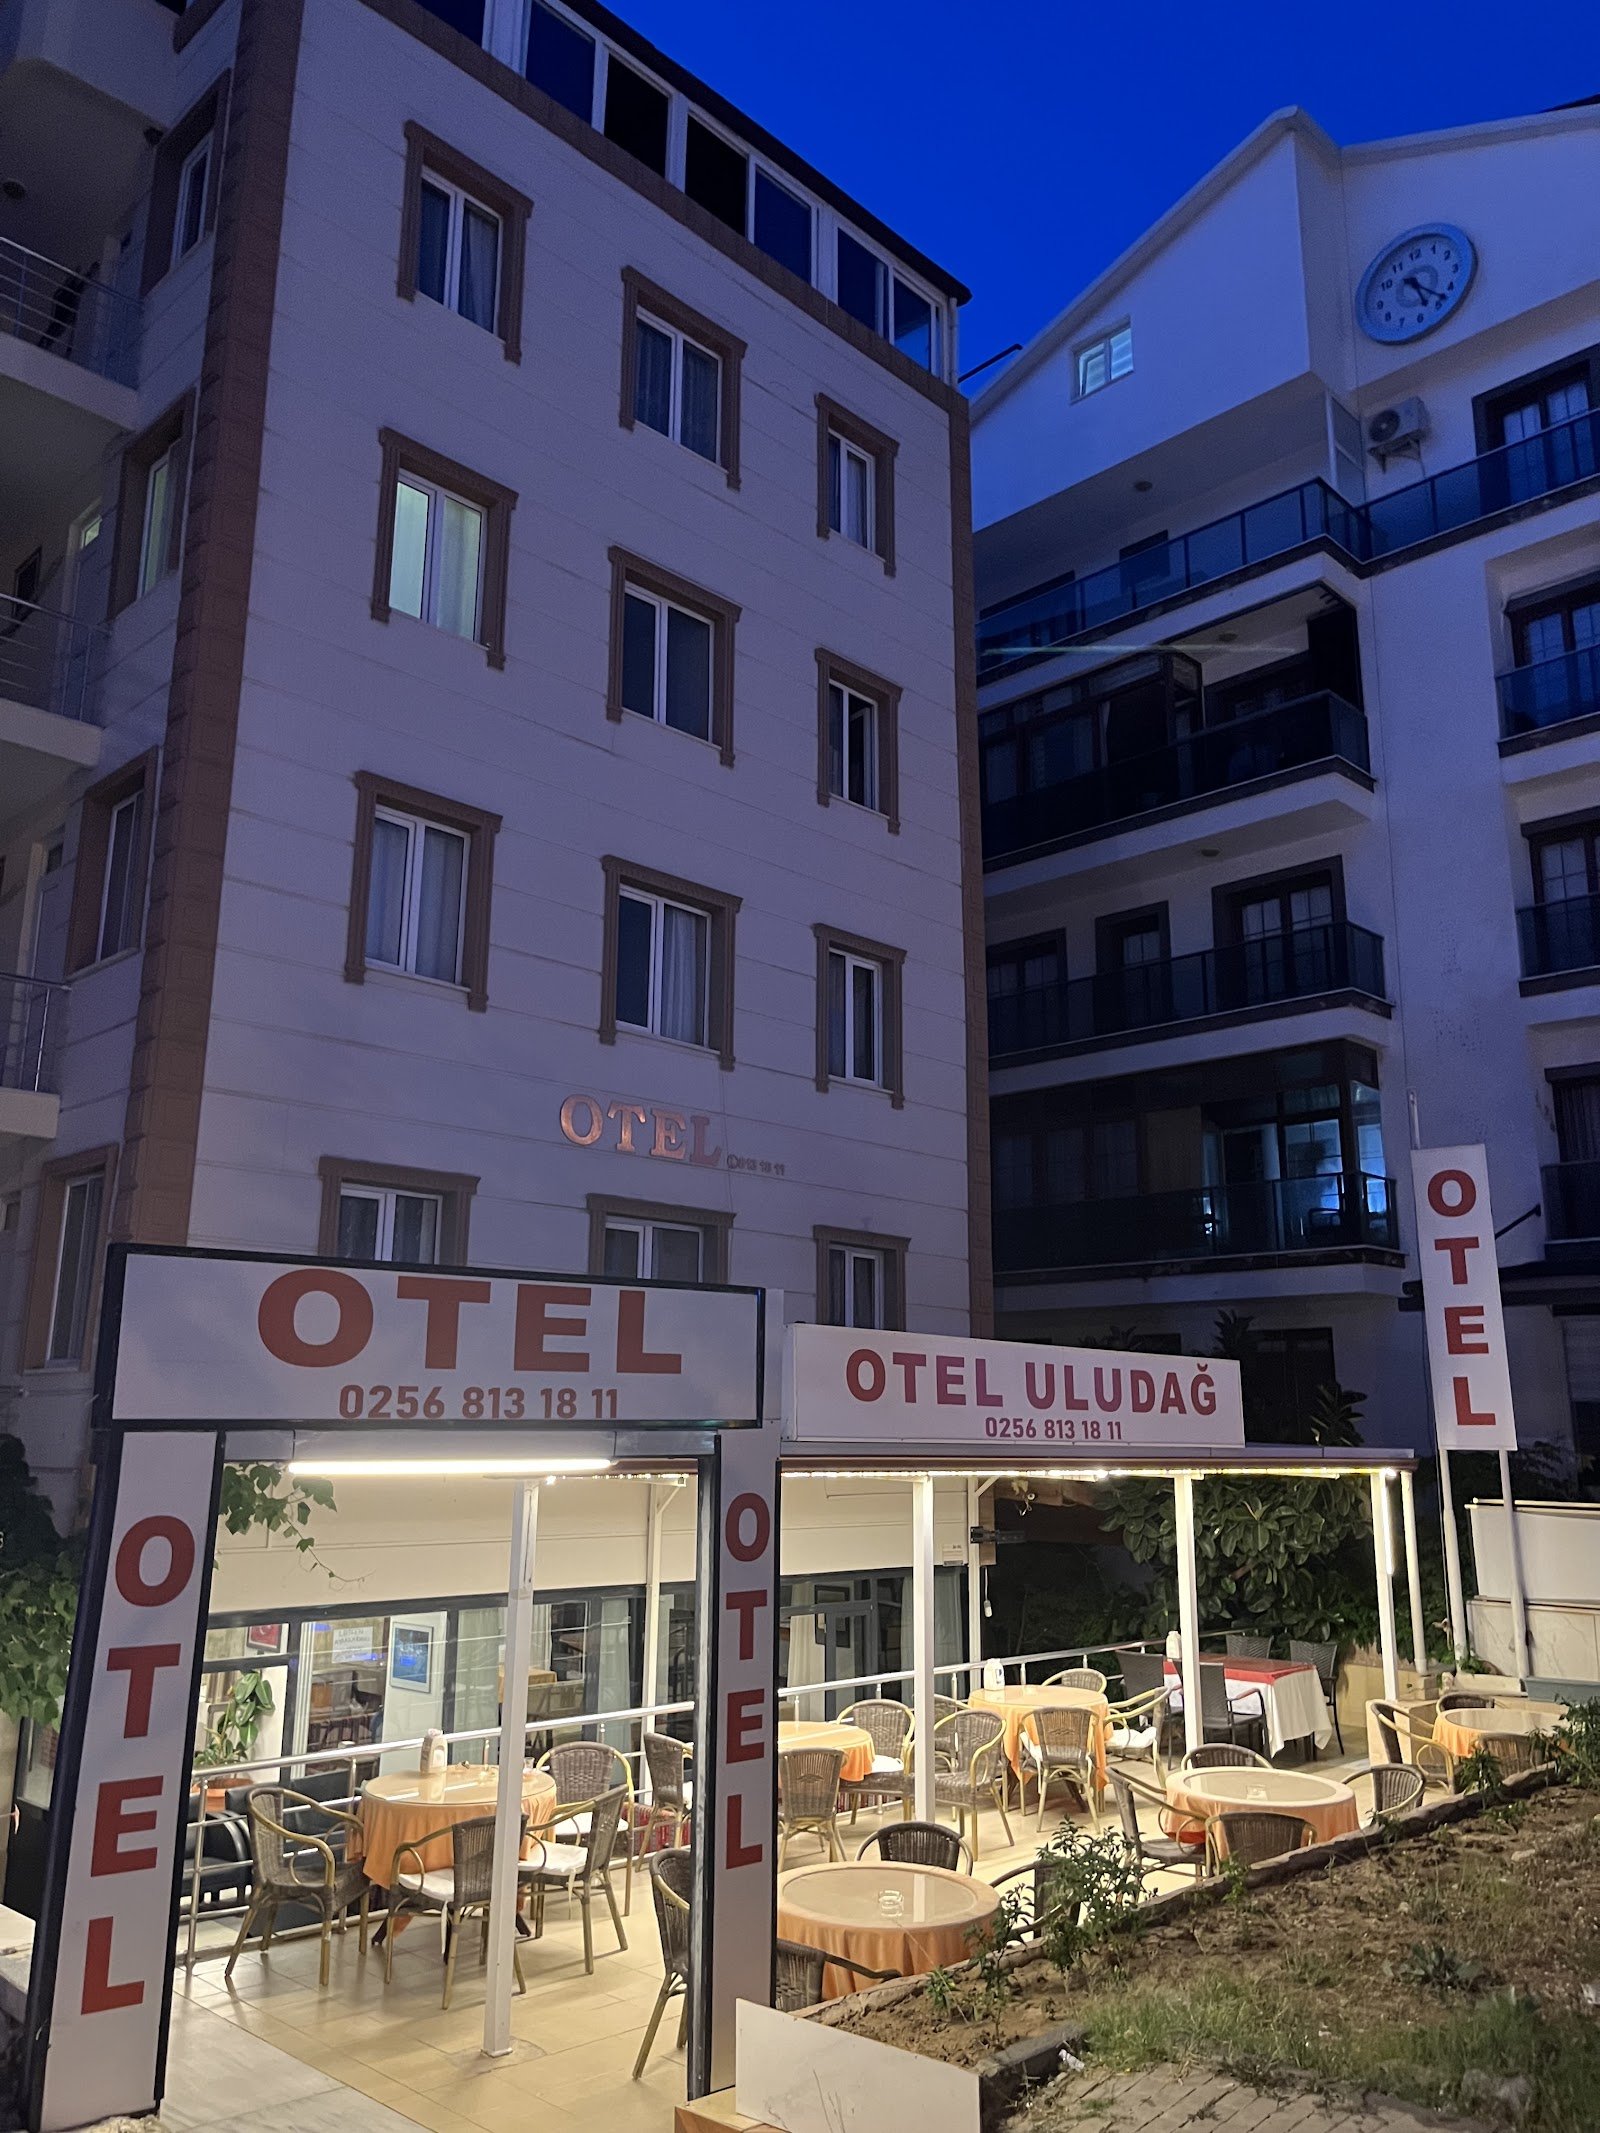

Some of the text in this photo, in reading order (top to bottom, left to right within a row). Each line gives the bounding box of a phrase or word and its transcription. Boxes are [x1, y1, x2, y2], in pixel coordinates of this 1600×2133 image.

[1381, 279, 1393, 291] 10
[1392, 262, 1403, 274] 11
[1409, 248, 1421, 261] 12
[560, 1093, 722, 1167] OTEL
[257, 1268, 682, 1374] OTEL
[1429, 1169, 1497, 1426] OTEL
[339, 1384, 618, 1420] 0256 813 18 11
[845, 1347, 1217, 1417] OTEL ULUDAĞ
[985, 1416, 1122, 1441] 0256 813 18 11
[724, 1492, 771, 1870] OTEL
[79, 1514, 196, 2016] OTEL
